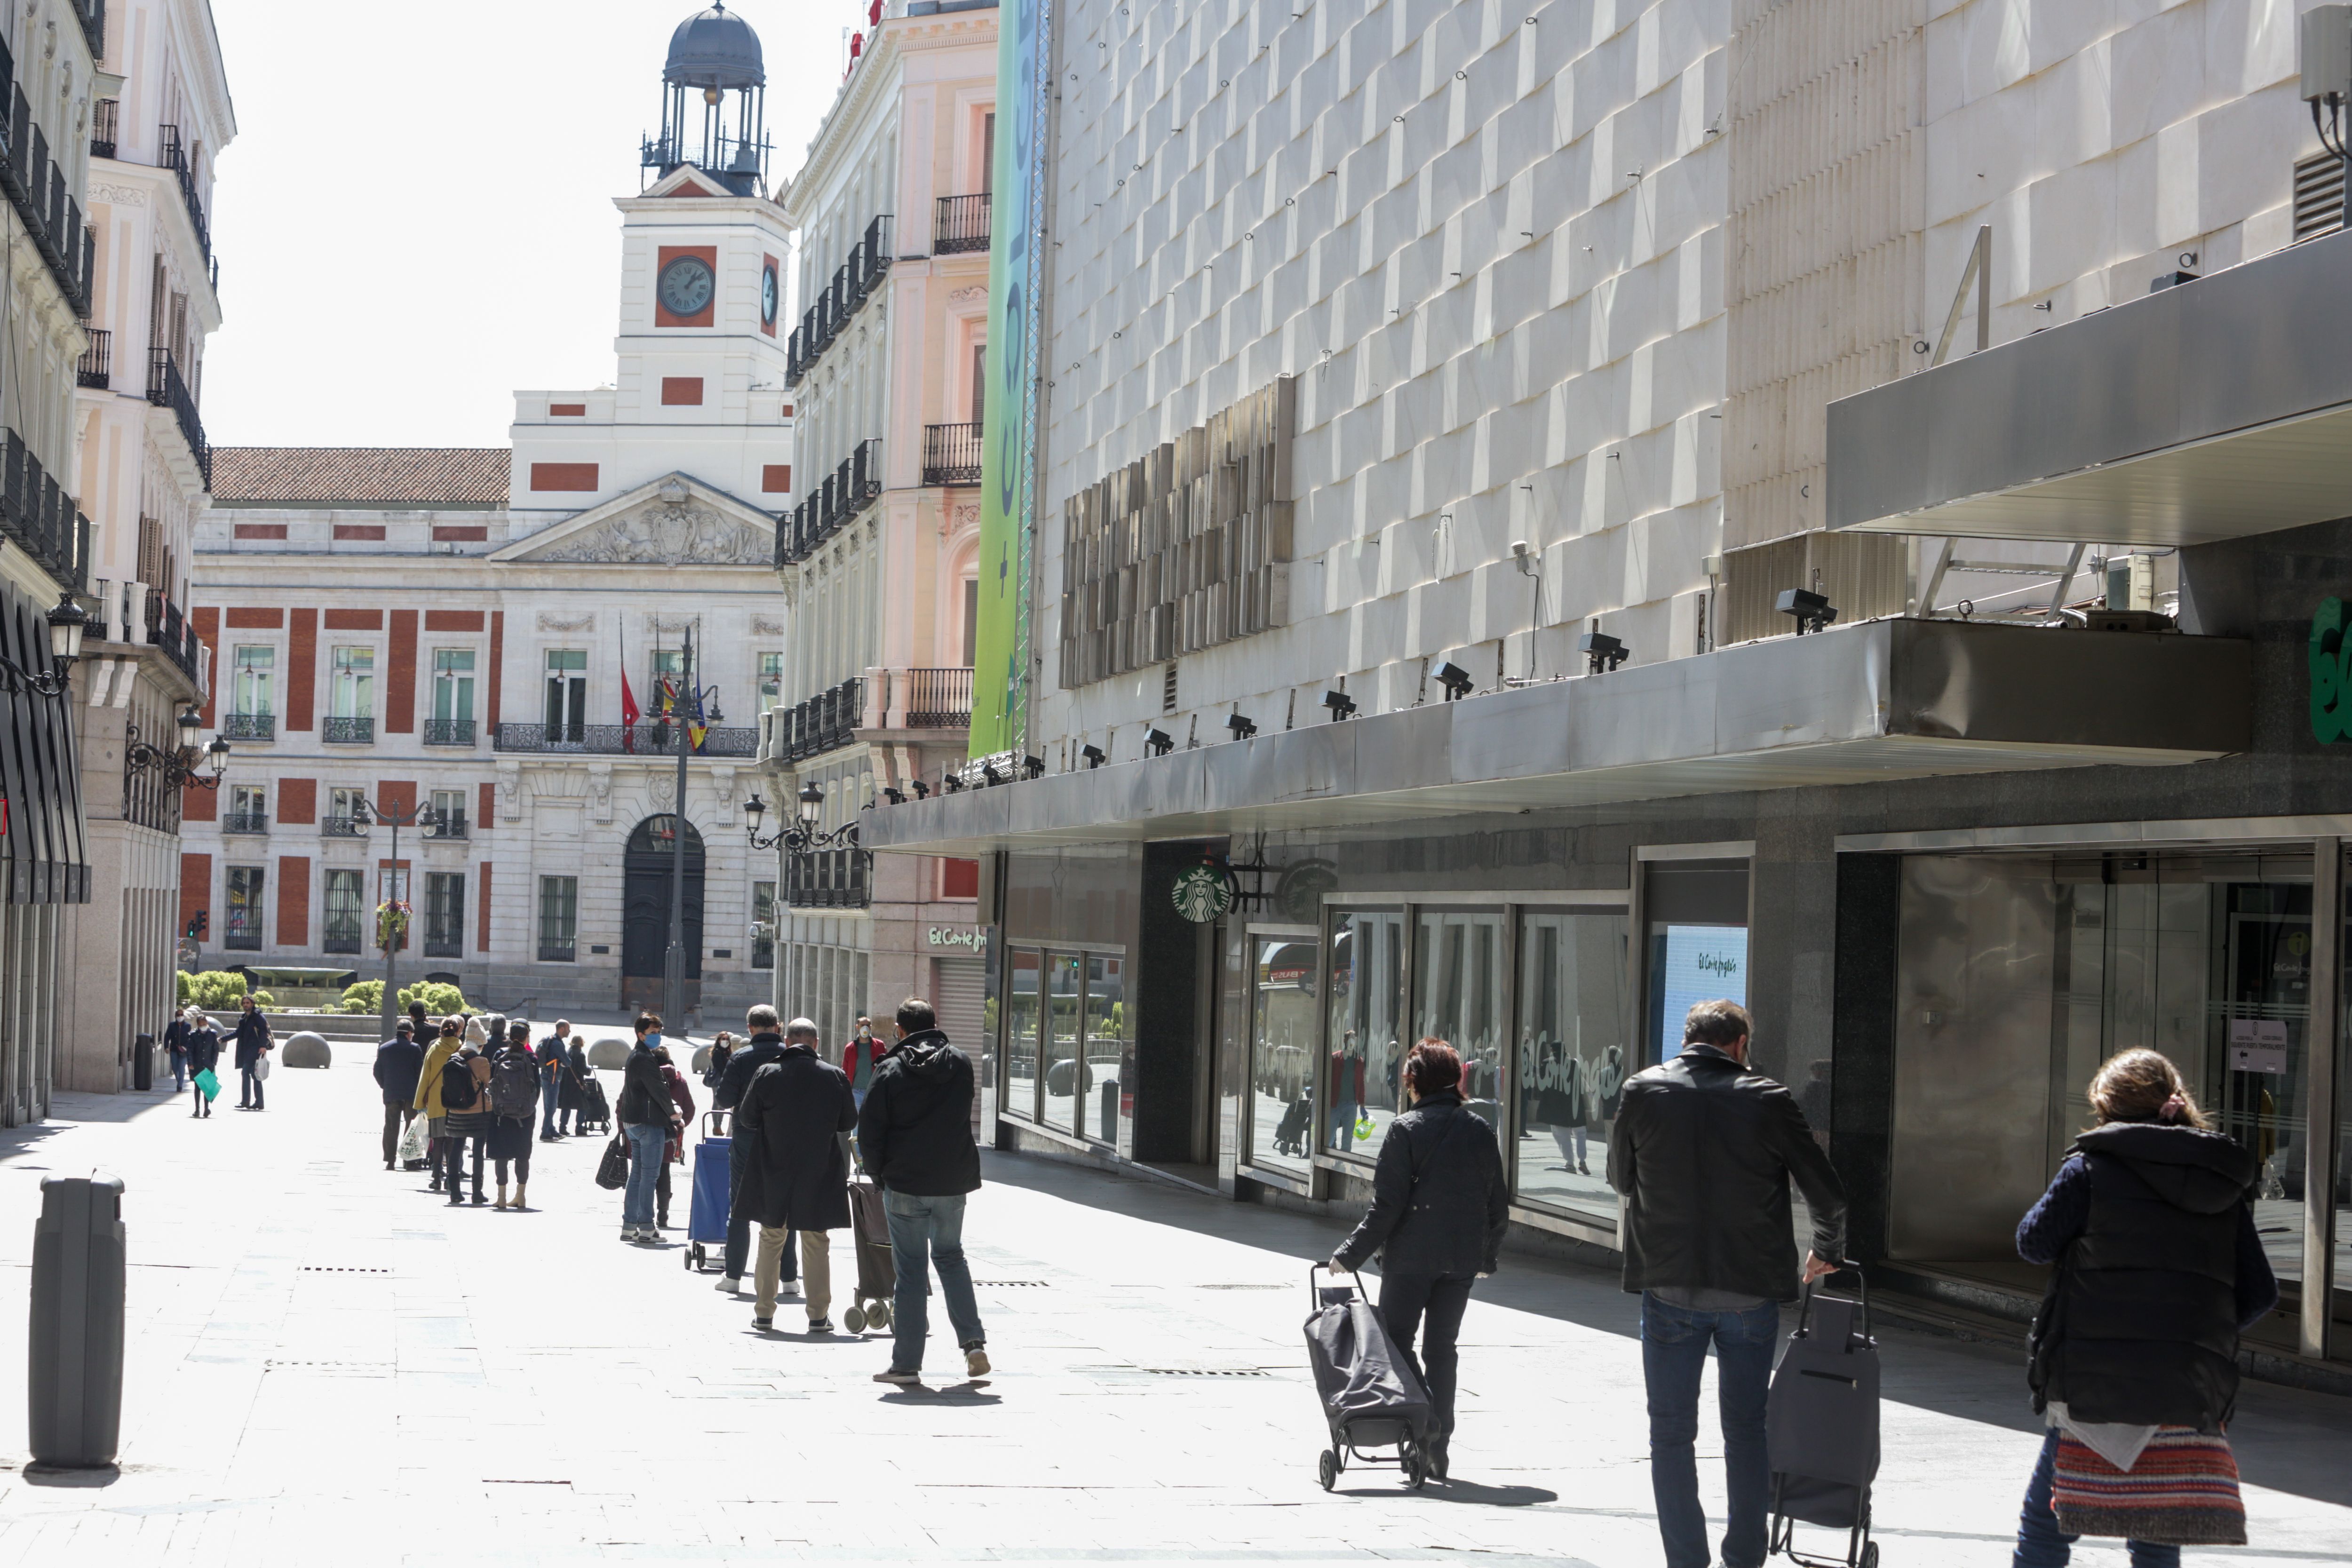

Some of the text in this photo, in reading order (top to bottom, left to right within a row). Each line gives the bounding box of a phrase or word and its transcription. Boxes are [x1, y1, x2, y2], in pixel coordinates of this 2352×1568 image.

[929, 927, 942, 945] El
[943, 928, 972, 946] Corte
[1699, 951, 1736, 978] El Corte Inglés
[1536, 1030, 1571, 1095] Corte
